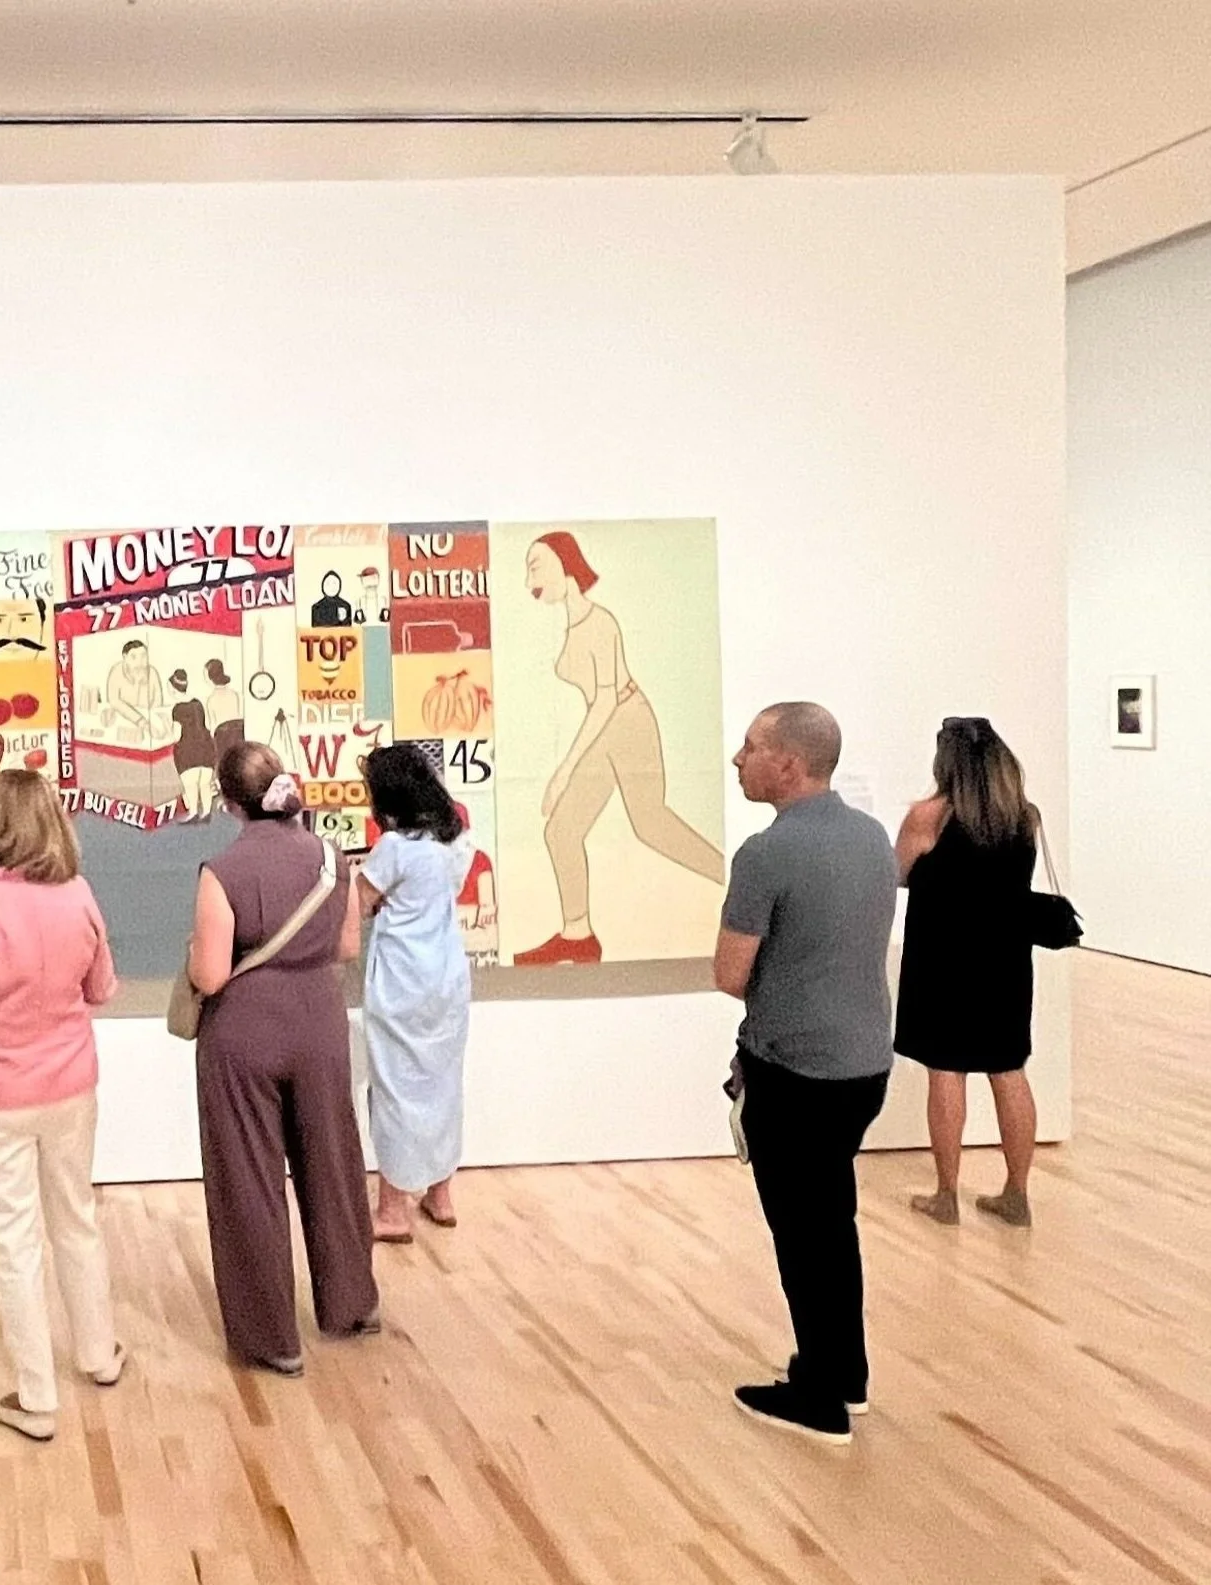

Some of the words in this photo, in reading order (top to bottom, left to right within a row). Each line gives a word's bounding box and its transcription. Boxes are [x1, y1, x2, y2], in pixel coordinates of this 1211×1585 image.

[70, 526, 219, 597] MONEY
[190, 558, 229, 583] 77
[88, 606, 123, 632] 77
[134, 589, 217, 624] MONEY
[222, 576, 294, 610] LOAN
[300, 635, 357, 662] TOP
[300, 688, 356, 700] TOBACCO
[449, 739, 492, 784] 45
[59, 788, 80, 812] 77
[83, 791, 115, 816] BUY
[113, 801, 146, 829] SELL
[154, 799, 178, 827] 77
